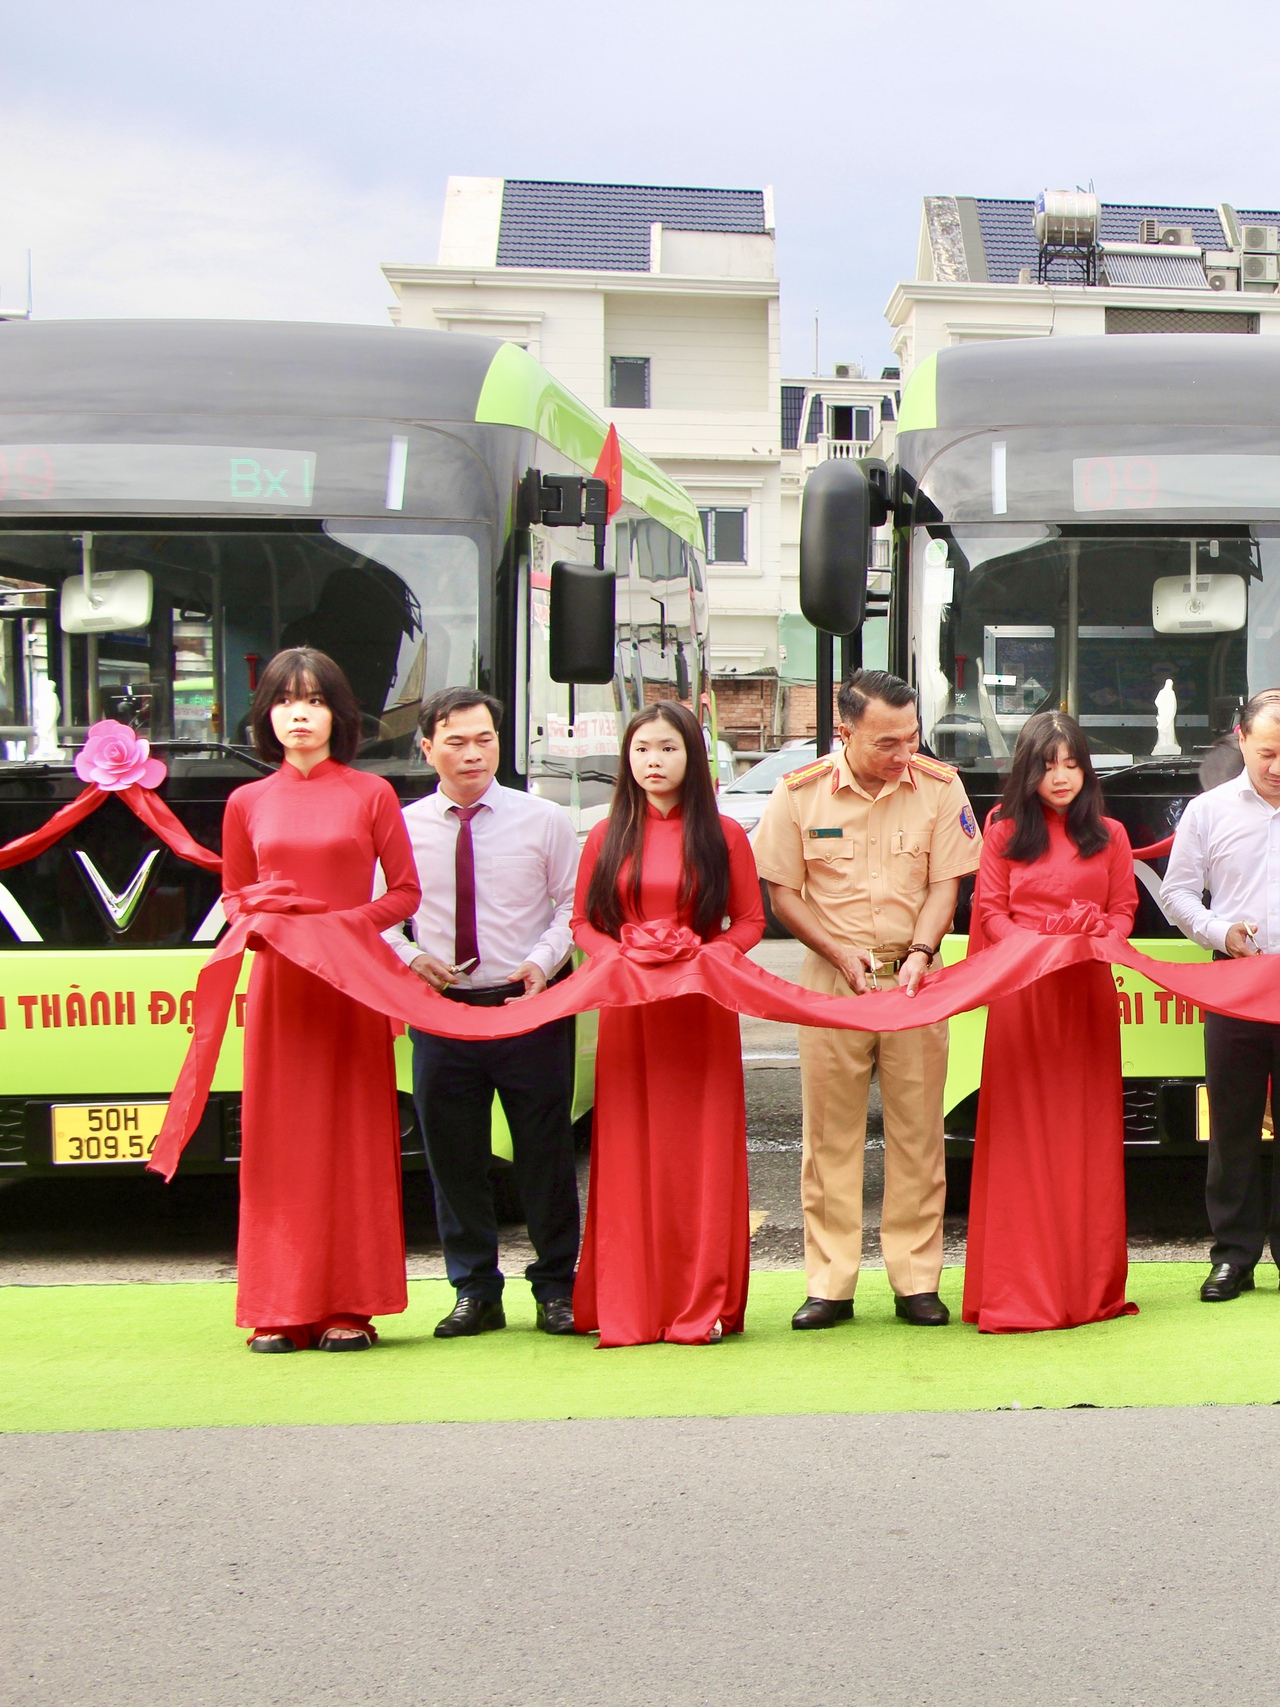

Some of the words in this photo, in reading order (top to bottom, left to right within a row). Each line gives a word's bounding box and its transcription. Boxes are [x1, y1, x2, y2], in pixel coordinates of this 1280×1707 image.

[230, 458, 289, 497] Bx
[1083, 457, 1158, 510] 09
[17, 984, 136, 1030] THÀNH
[147, 990, 196, 1034] ĐẠ
[88, 1107, 139, 1132] 50H
